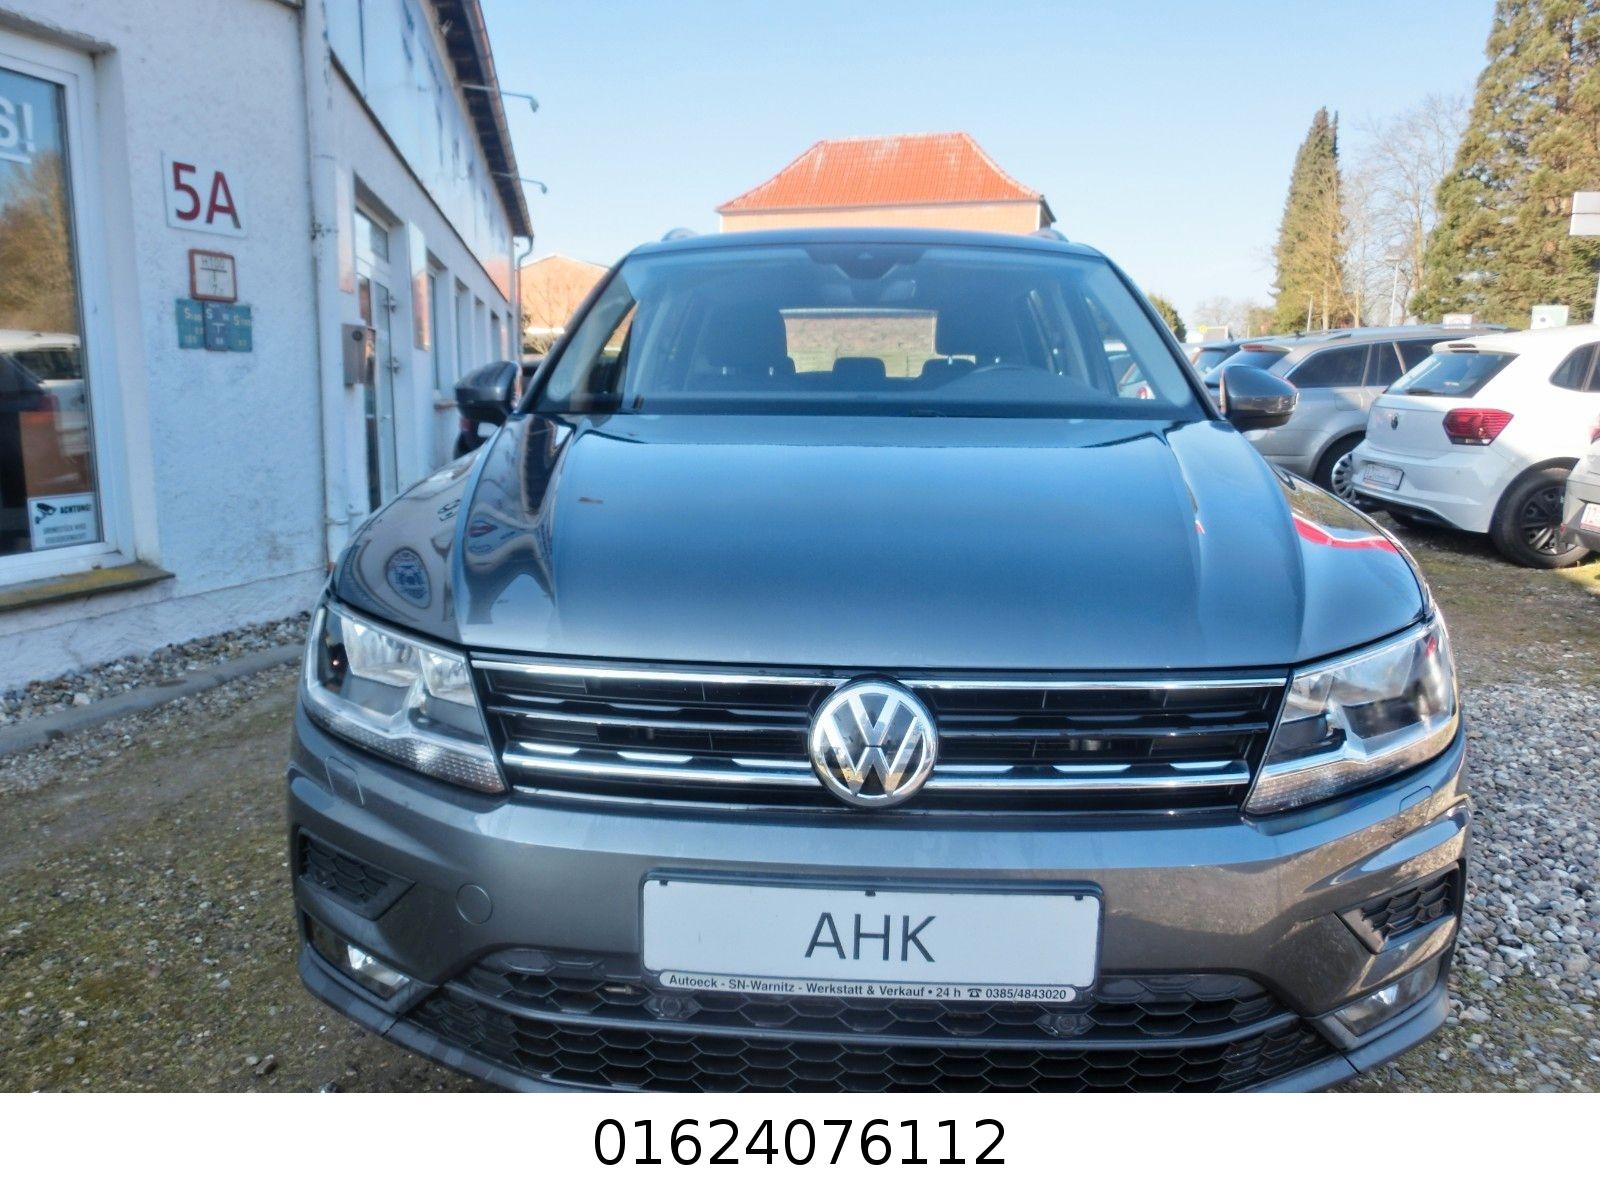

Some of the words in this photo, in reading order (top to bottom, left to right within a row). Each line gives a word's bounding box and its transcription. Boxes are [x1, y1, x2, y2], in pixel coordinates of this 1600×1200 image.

[173, 161, 241, 229] 5A
[804, 911, 935, 963] AHK
[669, 974, 717, 988] Autoeck
[728, 979, 795, 993] SN-Warnitz
[806, 983, 862, 995] Werkstatt
[866, 987, 875, 995] &
[879, 985, 926, 997] Verkauf
[936, 988, 949, 997] 24
[953, 988, 960, 997] h
[985, 988, 1066, 1000] 0385/4843020
